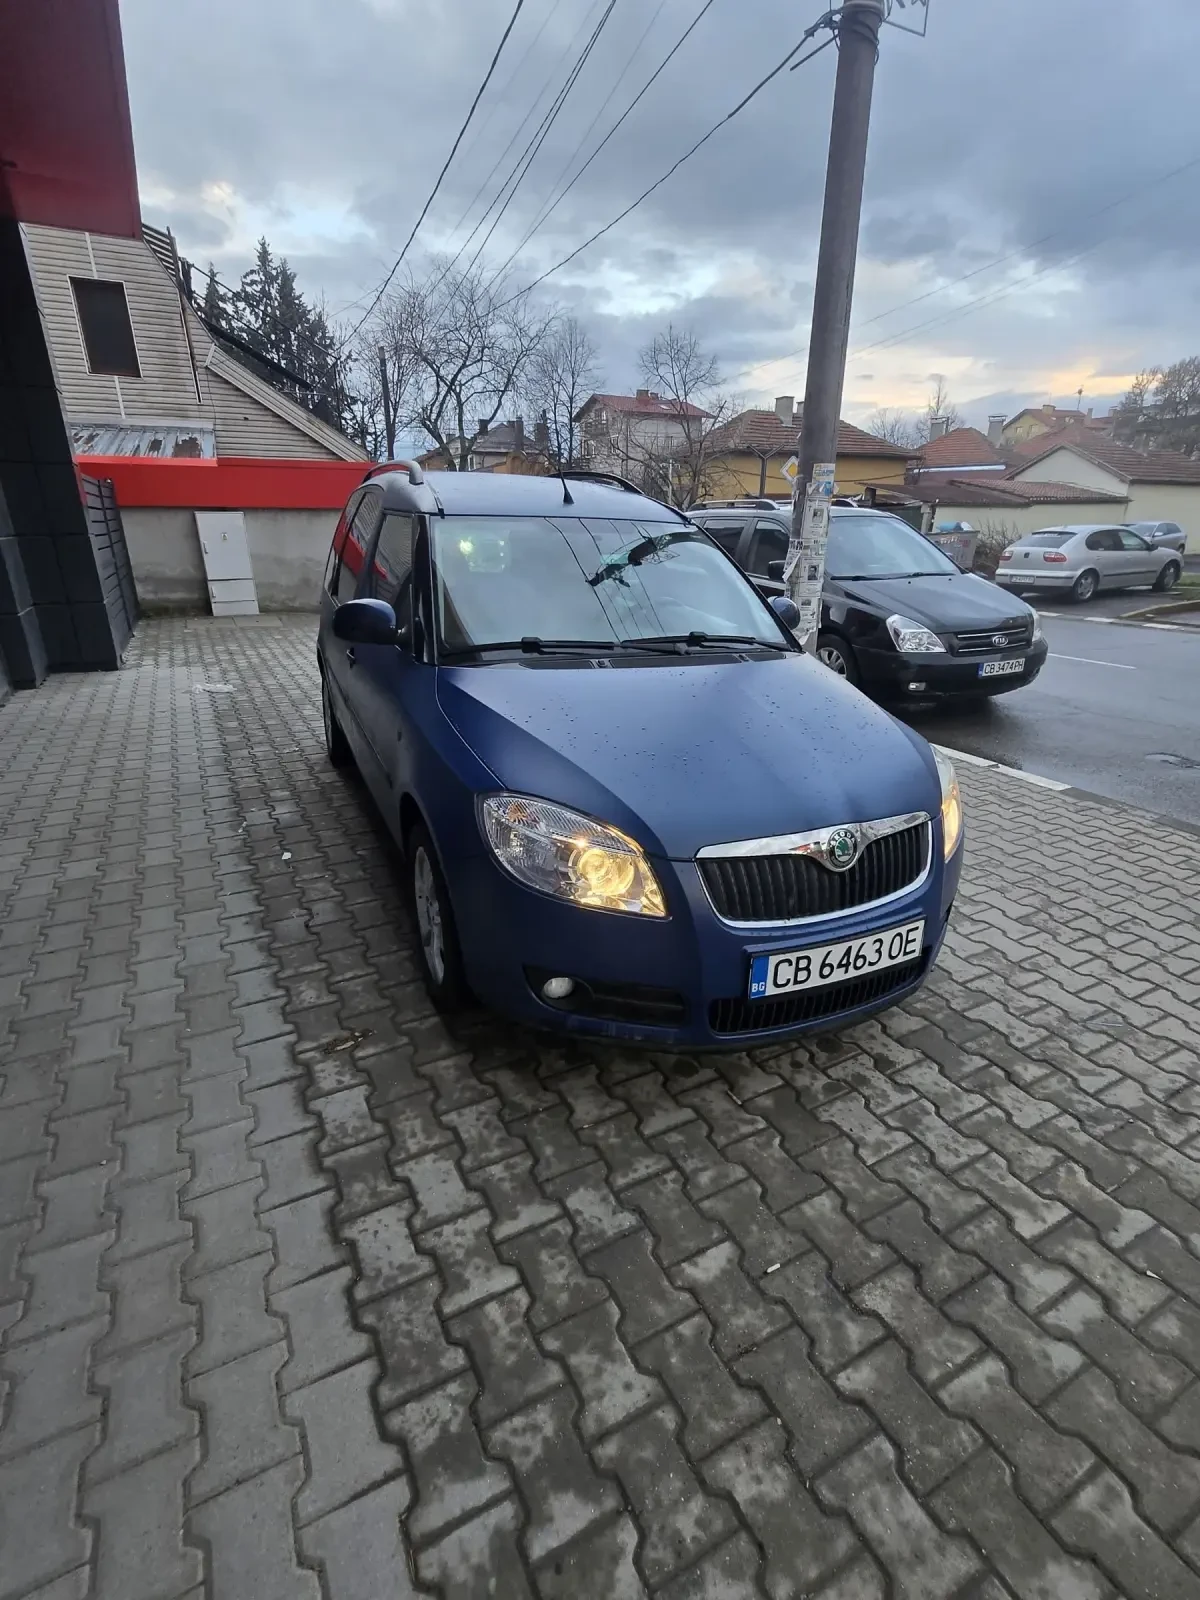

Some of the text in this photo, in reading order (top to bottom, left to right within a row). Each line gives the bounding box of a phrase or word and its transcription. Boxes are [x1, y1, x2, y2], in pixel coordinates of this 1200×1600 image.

[984, 660, 1024, 674] CB 3474 PH
[772, 925, 920, 988] CB 6463 OE
[752, 981, 766, 992] BG
